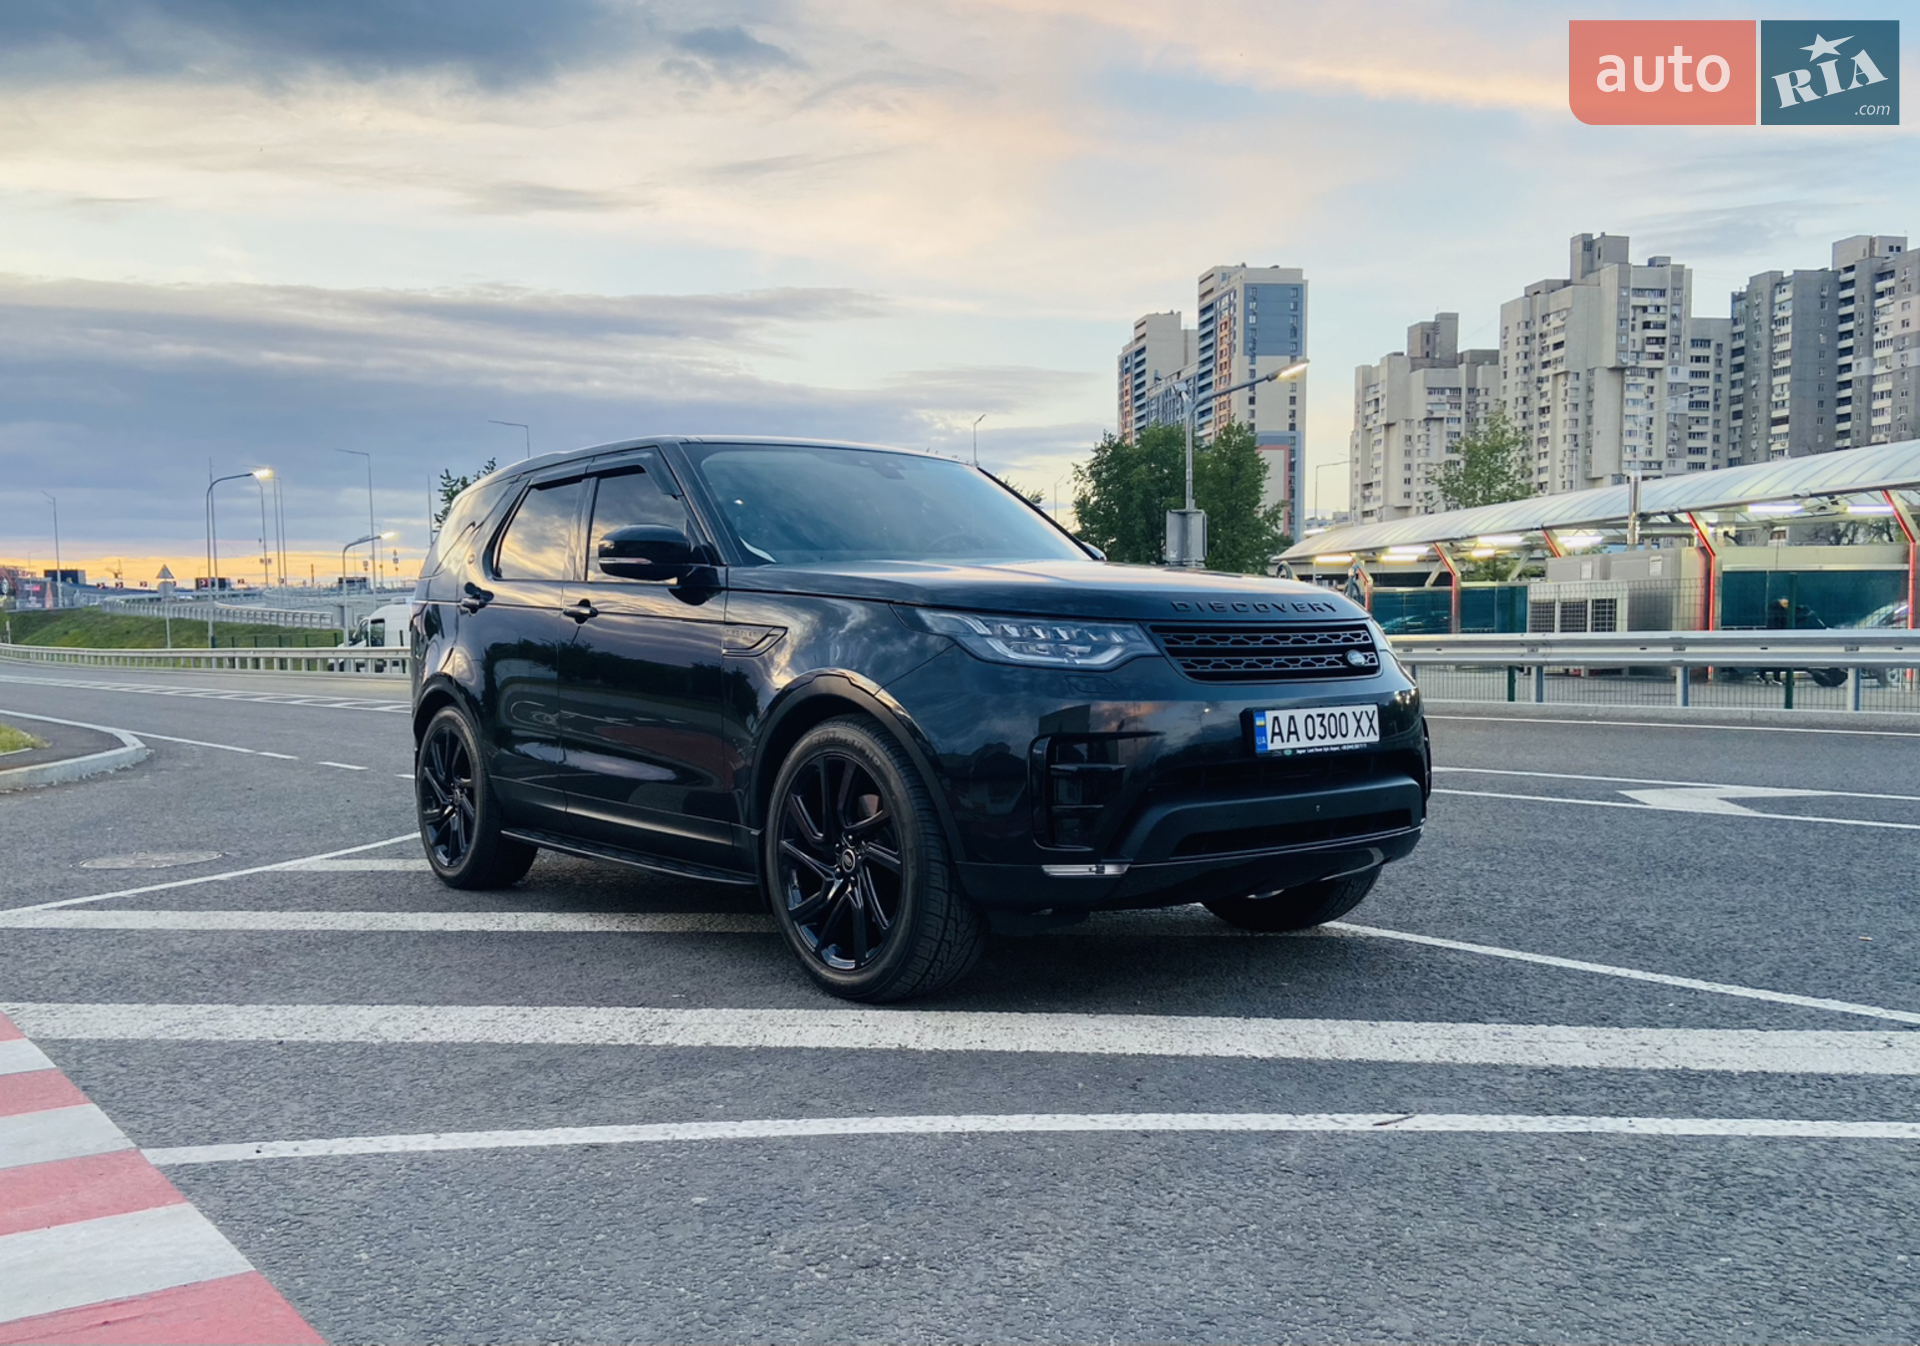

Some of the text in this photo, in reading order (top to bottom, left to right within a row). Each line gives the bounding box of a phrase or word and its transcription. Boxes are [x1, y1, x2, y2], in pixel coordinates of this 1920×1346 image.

[1170, 600, 1338, 613] DISCOVERY
[1270, 710, 1378, 744] AA 0300 XX
